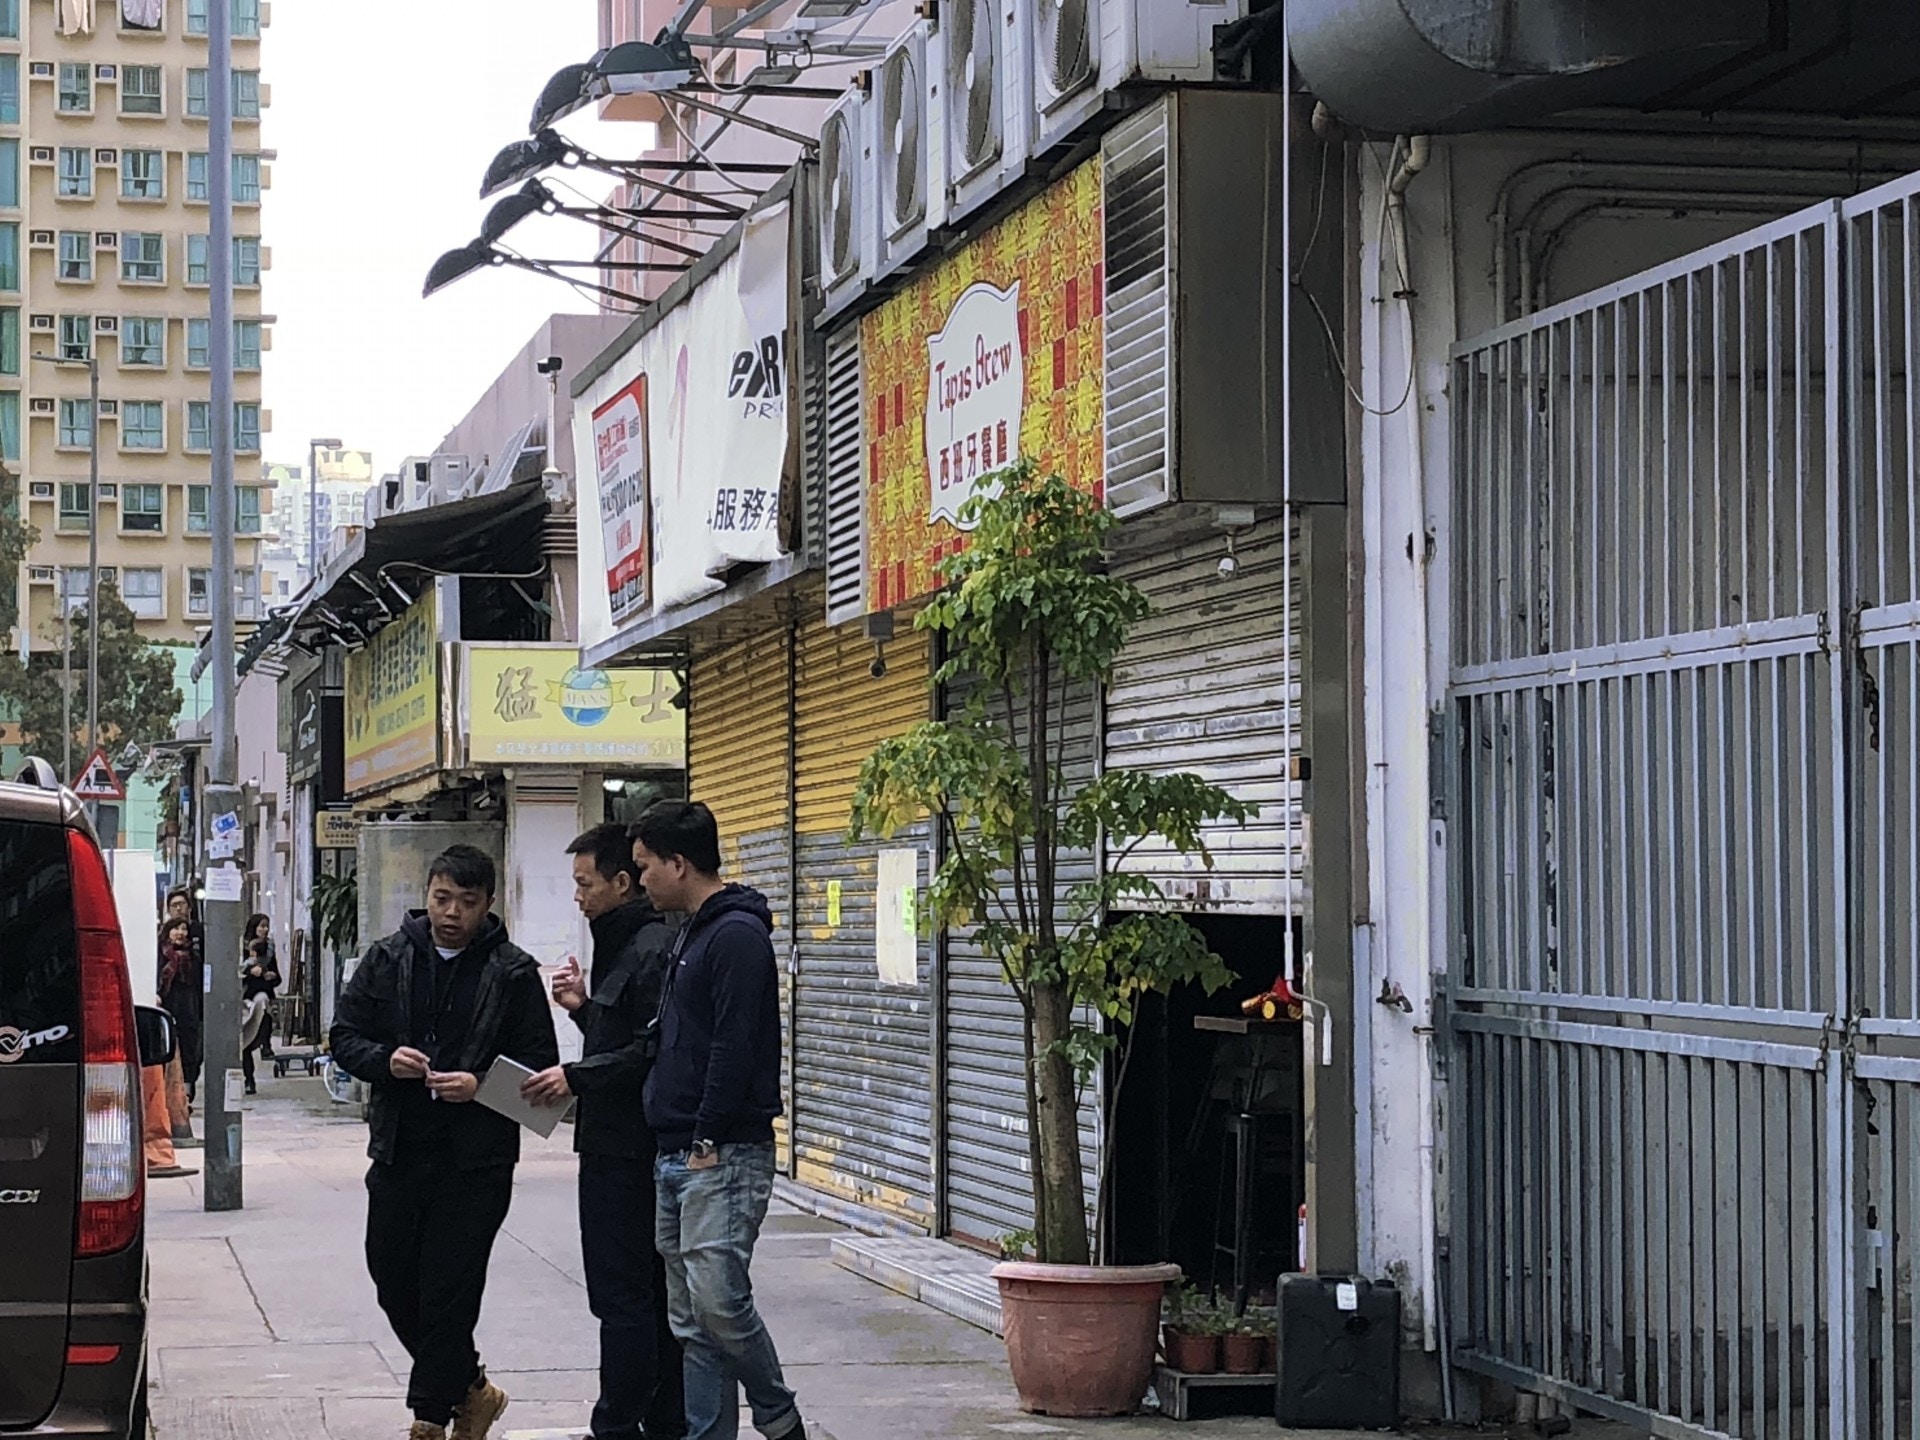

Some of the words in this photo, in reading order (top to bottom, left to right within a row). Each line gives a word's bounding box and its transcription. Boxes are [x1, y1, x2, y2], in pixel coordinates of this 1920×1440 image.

[934, 360, 972, 413] Tapas
[975, 333, 1012, 391] Brew
[939, 417, 1008, 492] 西班牙餐廳
[493, 666, 543, 723] 猛
[629, 670, 677, 724] 士
